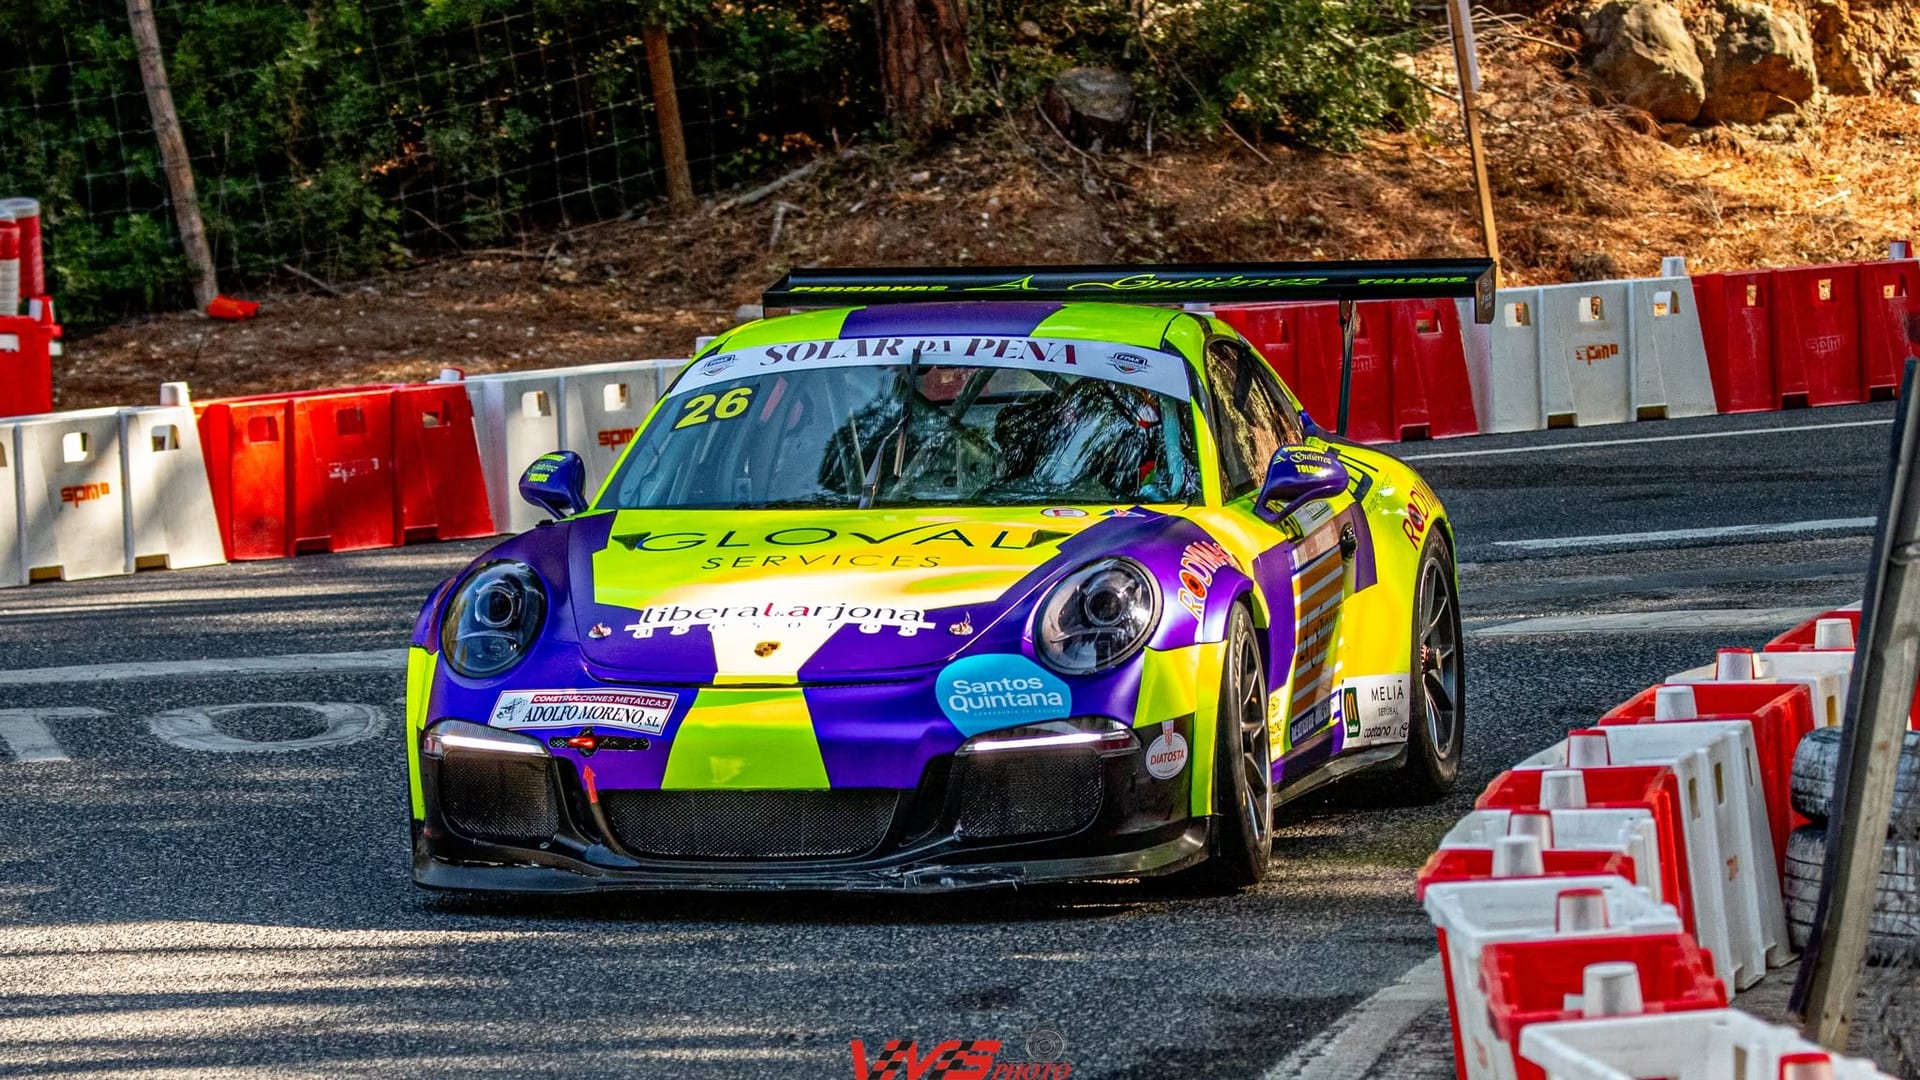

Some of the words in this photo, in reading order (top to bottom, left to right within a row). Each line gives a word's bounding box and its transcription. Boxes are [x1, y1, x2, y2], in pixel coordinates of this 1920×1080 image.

[1357, 276, 1468, 285] TOLDOS
[759, 338, 904, 366] SOLAR
[964, 338, 1078, 365] PENA
[676, 387, 753, 429] 26
[636, 521, 1030, 552] GLOVAL
[700, 554, 942, 570] SERVICES
[952, 677, 1043, 695] Santos
[533, 694, 614, 704] CONSTRUCCIONES
[614, 696, 668, 708] METÁLICAS
[948, 691, 1063, 713] Quintana
[523, 705, 579, 722] ADOLFO
[578, 706, 643, 727] MORENO,
[1150, 749, 1185, 765] DIATOSTA
